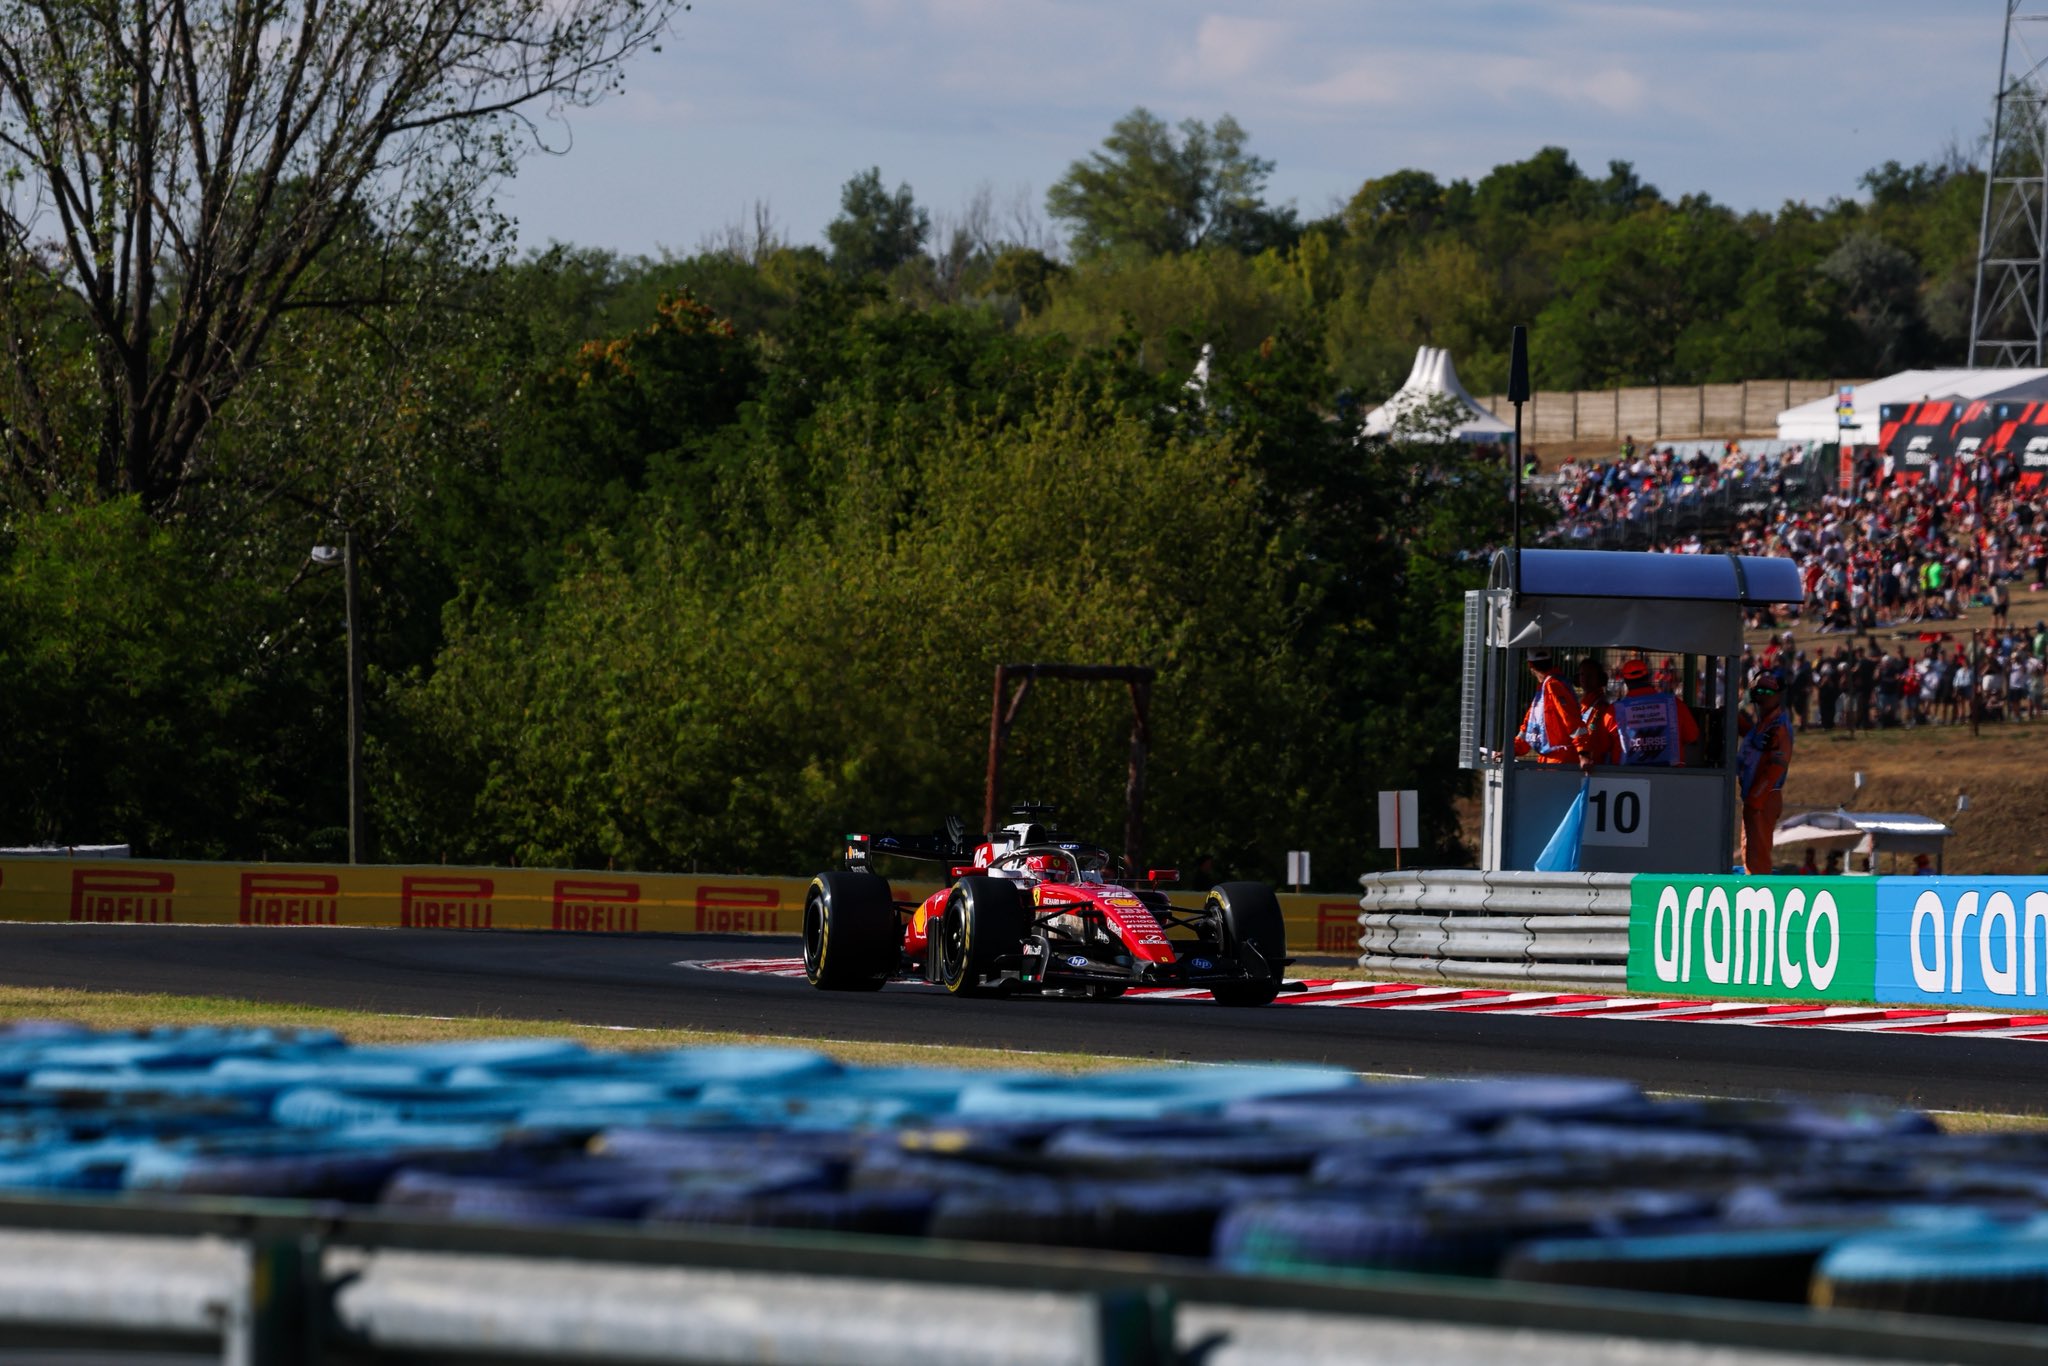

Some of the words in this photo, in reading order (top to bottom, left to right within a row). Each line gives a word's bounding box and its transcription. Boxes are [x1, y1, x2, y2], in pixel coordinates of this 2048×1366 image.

[1589, 790, 1640, 834] 10
[69, 869, 175, 923] PIRELLI
[240, 872, 339, 926] PIRELLI
[400, 876, 494, 929] PIRELLI
[552, 880, 640, 931] PIRELLI
[696, 886, 780, 932] PIRELLI
[1070, 956, 1086, 966] hp
[1194, 958, 1209, 969] hp
[1654, 885, 1840, 991] aramco
